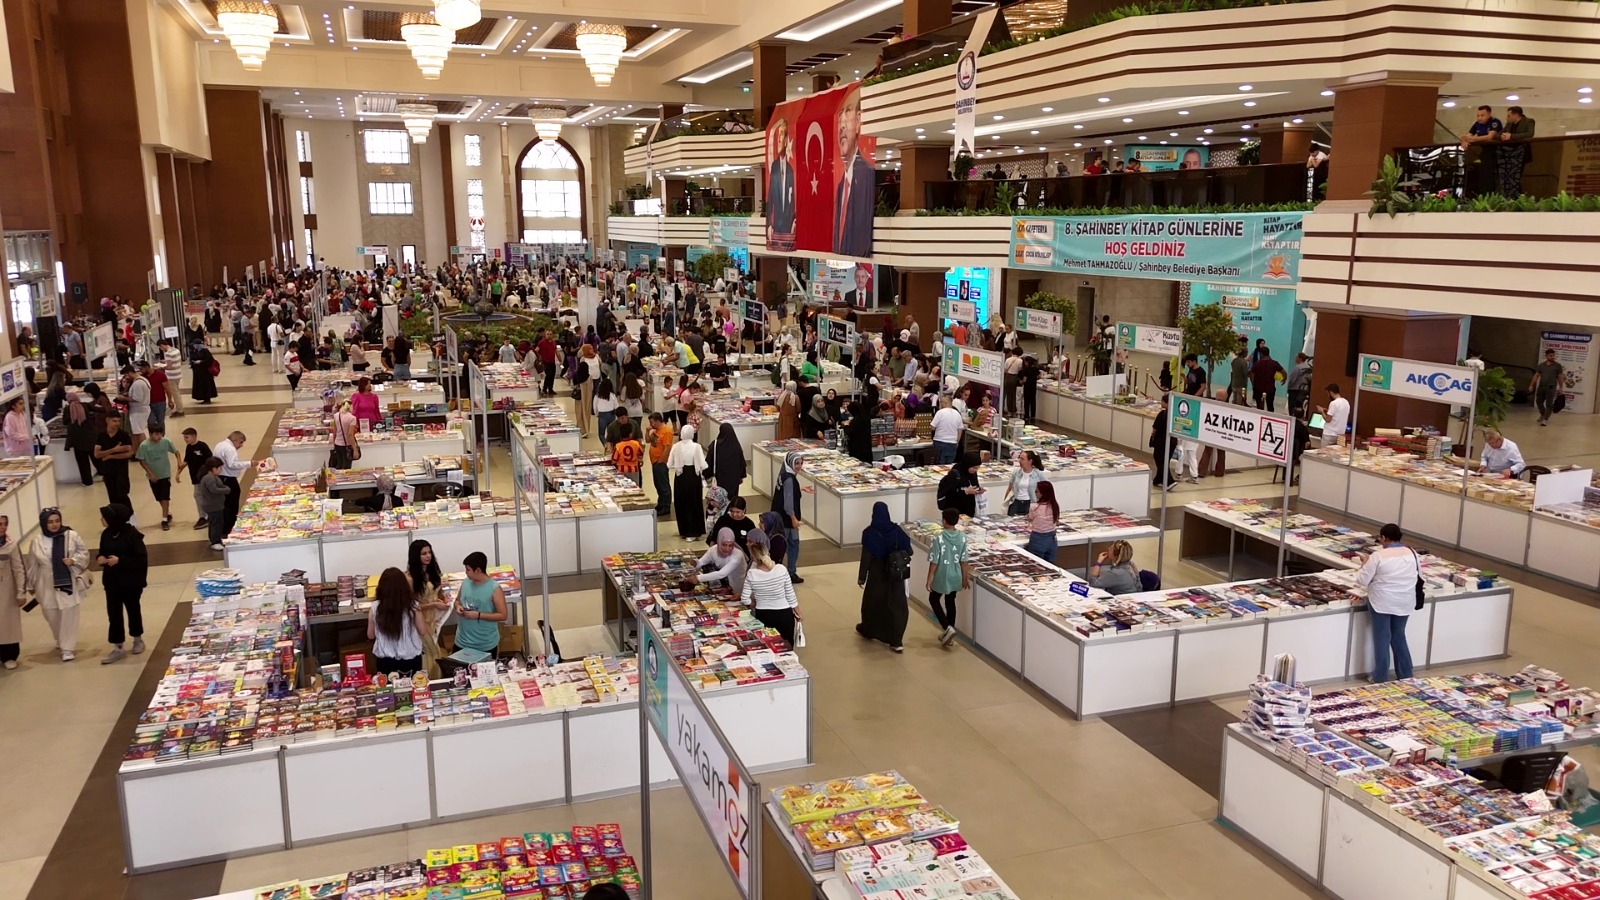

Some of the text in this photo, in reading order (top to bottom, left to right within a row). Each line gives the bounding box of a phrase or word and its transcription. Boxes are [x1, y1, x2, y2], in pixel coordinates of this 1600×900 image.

[1065, 217, 1243, 237] 8. ŞAHİNBEY KİTAP GÜNLERİNE
[1263, 216, 1281, 224] KİTAP
[1263, 220, 1303, 234] HAYATTIR
[1105, 239, 1185, 257] HOŞ GELDİNİZ
[1261, 240, 1300, 250] KİTAPTIR
[1063, 258, 1086, 268] Mehmet
[1088, 258, 1132, 271] TAHMAZOĞLU
[1139, 261, 1171, 274] Şahinbey
[1173, 263, 1206, 276] Belediye
[1207, 265, 1240, 277] Başkanı
[1239, 286, 1278, 296] BELEDİYESİ
[1405, 372, 1473, 396] AKÇAĞ
[1204, 412, 1219, 427] AZ
[1221, 414, 1255, 434] KİTAP
[622, 446, 634, 463] 9
[676, 703, 750, 860] yakamoz
